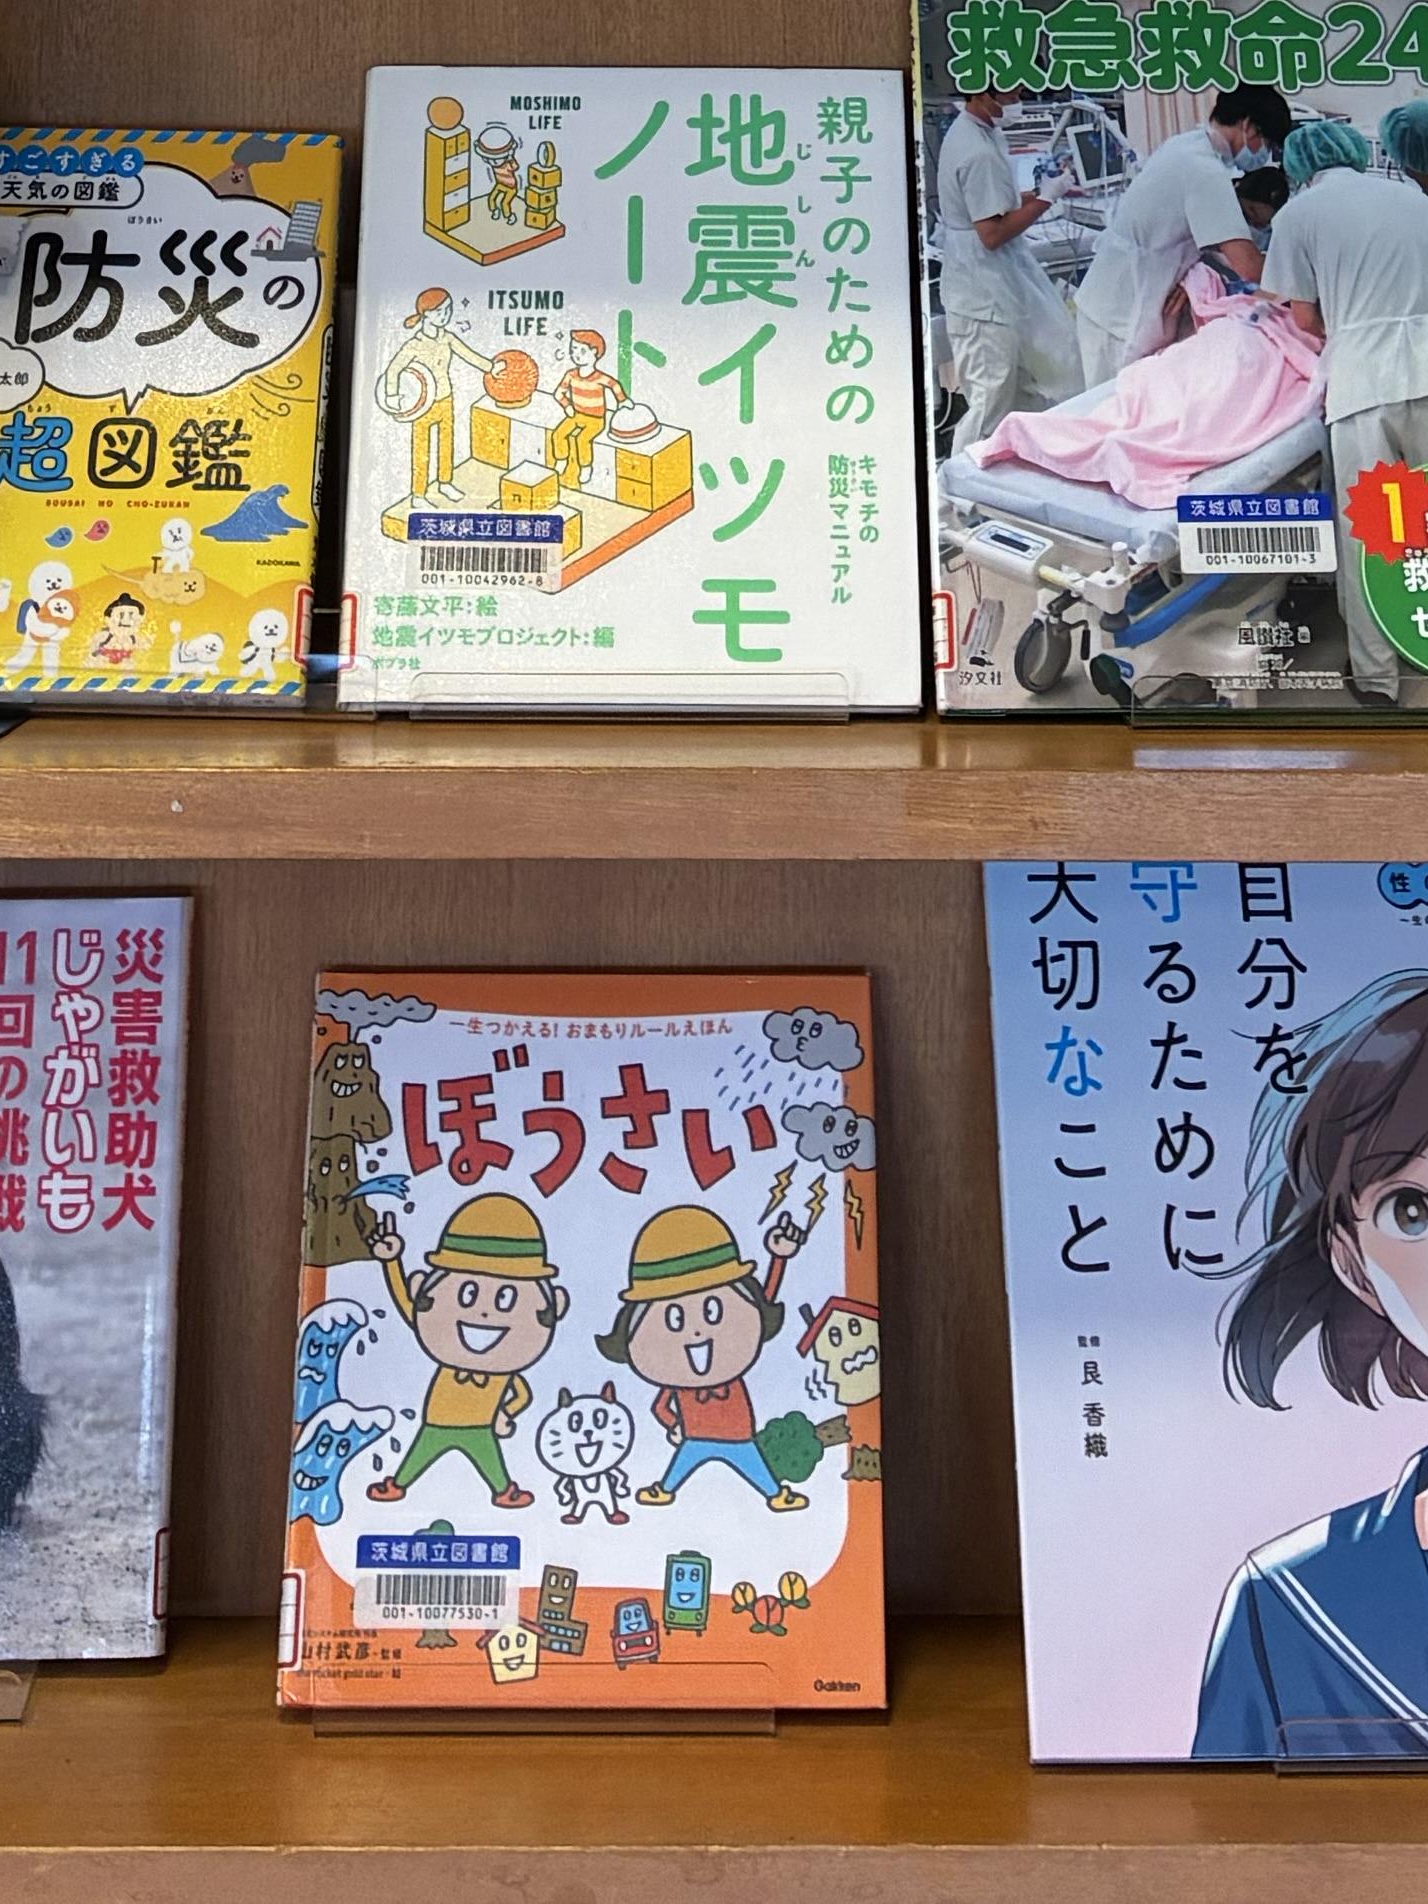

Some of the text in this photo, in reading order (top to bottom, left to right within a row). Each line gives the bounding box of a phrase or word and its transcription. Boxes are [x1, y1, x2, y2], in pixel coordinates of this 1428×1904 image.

[509, 94, 583, 112] MOSHIMO
[528, 115, 562, 131] LIFE
[0, 178, 121, 202] 天気の図鑑
[593, 99, 670, 398] ノート
[816, 95, 875, 428] 親子のための
[15, 228, 306, 349] 防災の
[487, 290, 565, 311] ITSUMO
[503, 315, 548, 337] LIFE
[681, 93, 799, 664] 地震イツモ
[857, 454, 881, 543] キモチの
[1189, 497, 1321, 518] 茨城県立図書館
[1380, 480, 1407, 544] 1
[416, 518, 553, 539] 茨城県立図書館
[828, 454, 853, 605] 防災マニュアル
[421, 572, 545, 587] 001-10042962-8
[1205, 552, 1318, 567] 001-10067101-3
[566, 1017, 732, 1040] おまもりルールえほん
[35, 925, 104, 1236] じゃがいも
[102, 927, 166, 1233] 災害救助犬
[1026, 863, 1113, 1276] 大切なこと
[1130, 863, 1225, 1273] 守るために
[402, 1044, 778, 1198] ぼうさい
[370, 1542, 510, 1563] 茨城県立図書館
[382, 1604, 500, 1621] 001-10077530-1
